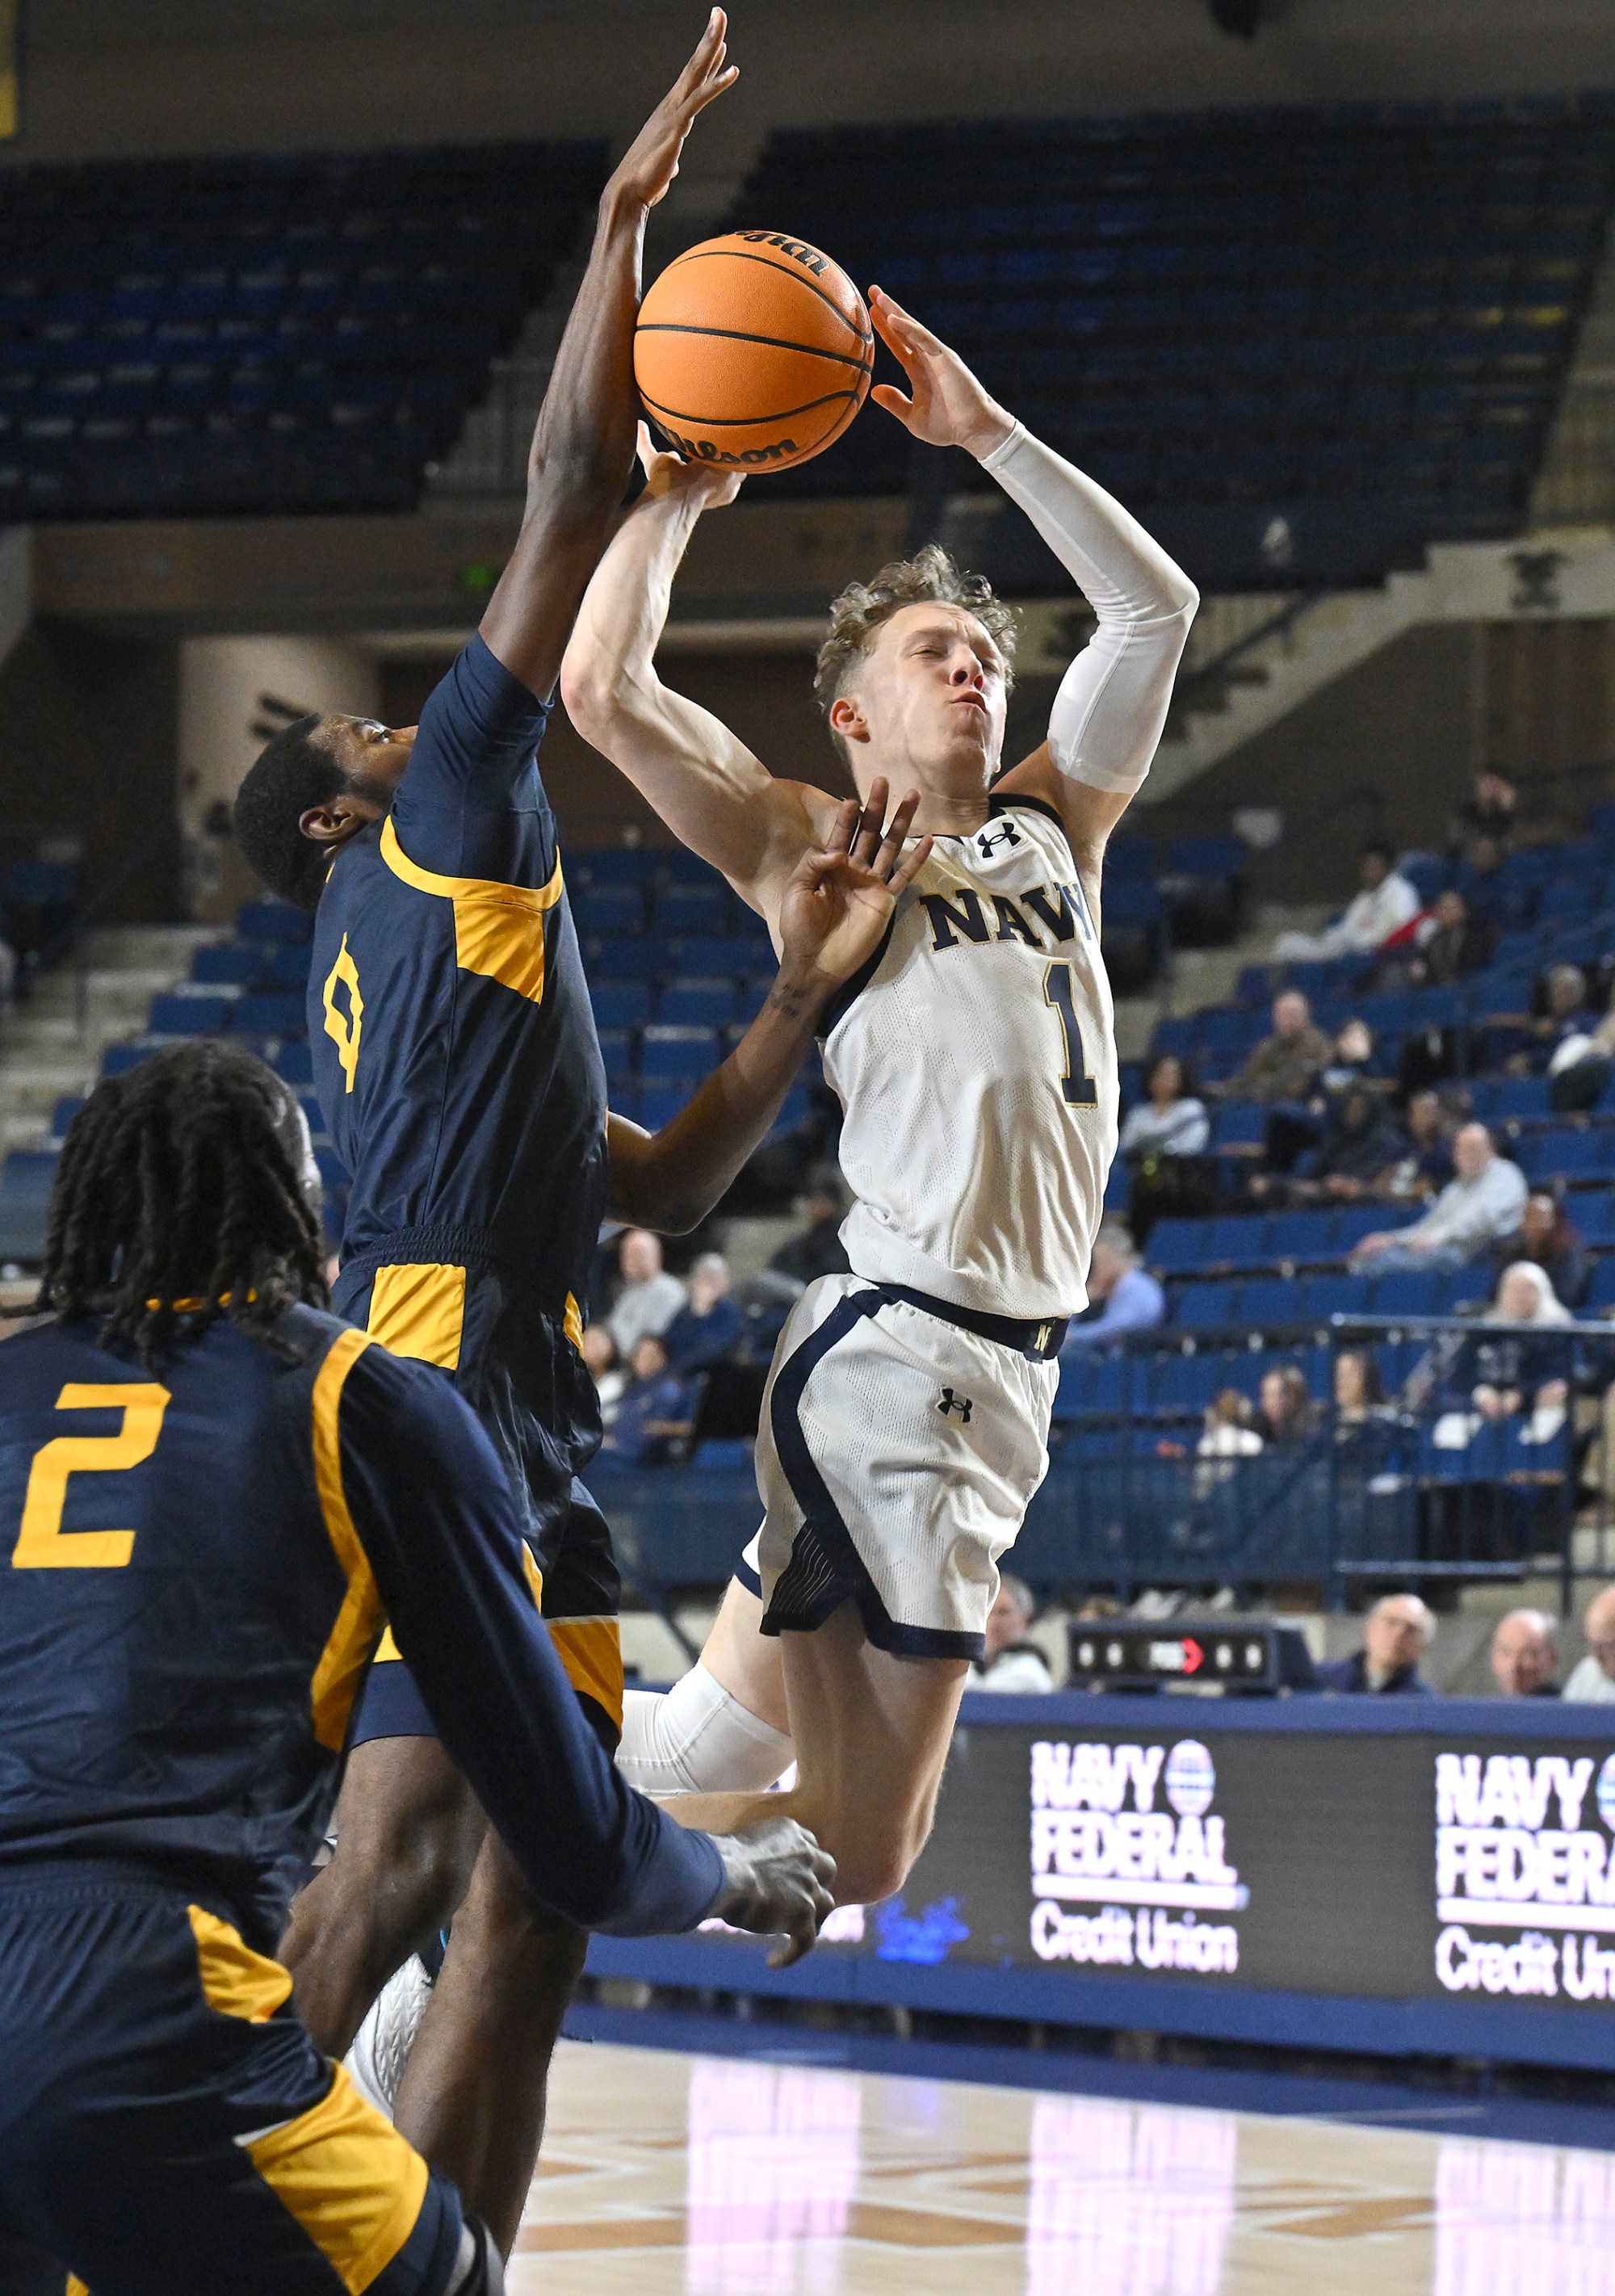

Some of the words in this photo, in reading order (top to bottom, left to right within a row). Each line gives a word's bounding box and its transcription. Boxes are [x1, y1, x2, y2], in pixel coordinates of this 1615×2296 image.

[1042, 959, 1098, 1108] 1
[11, 1382, 172, 1568] 2
[1030, 1741, 1165, 1813] NAVY
[1435, 1753, 1595, 1830] NAVY
[1030, 1809, 1237, 1884] FEDERAL
[1030, 1899, 1135, 1966] Credit
[1135, 1906, 1239, 1973] Union
[1435, 1925, 1558, 1997] Credit
